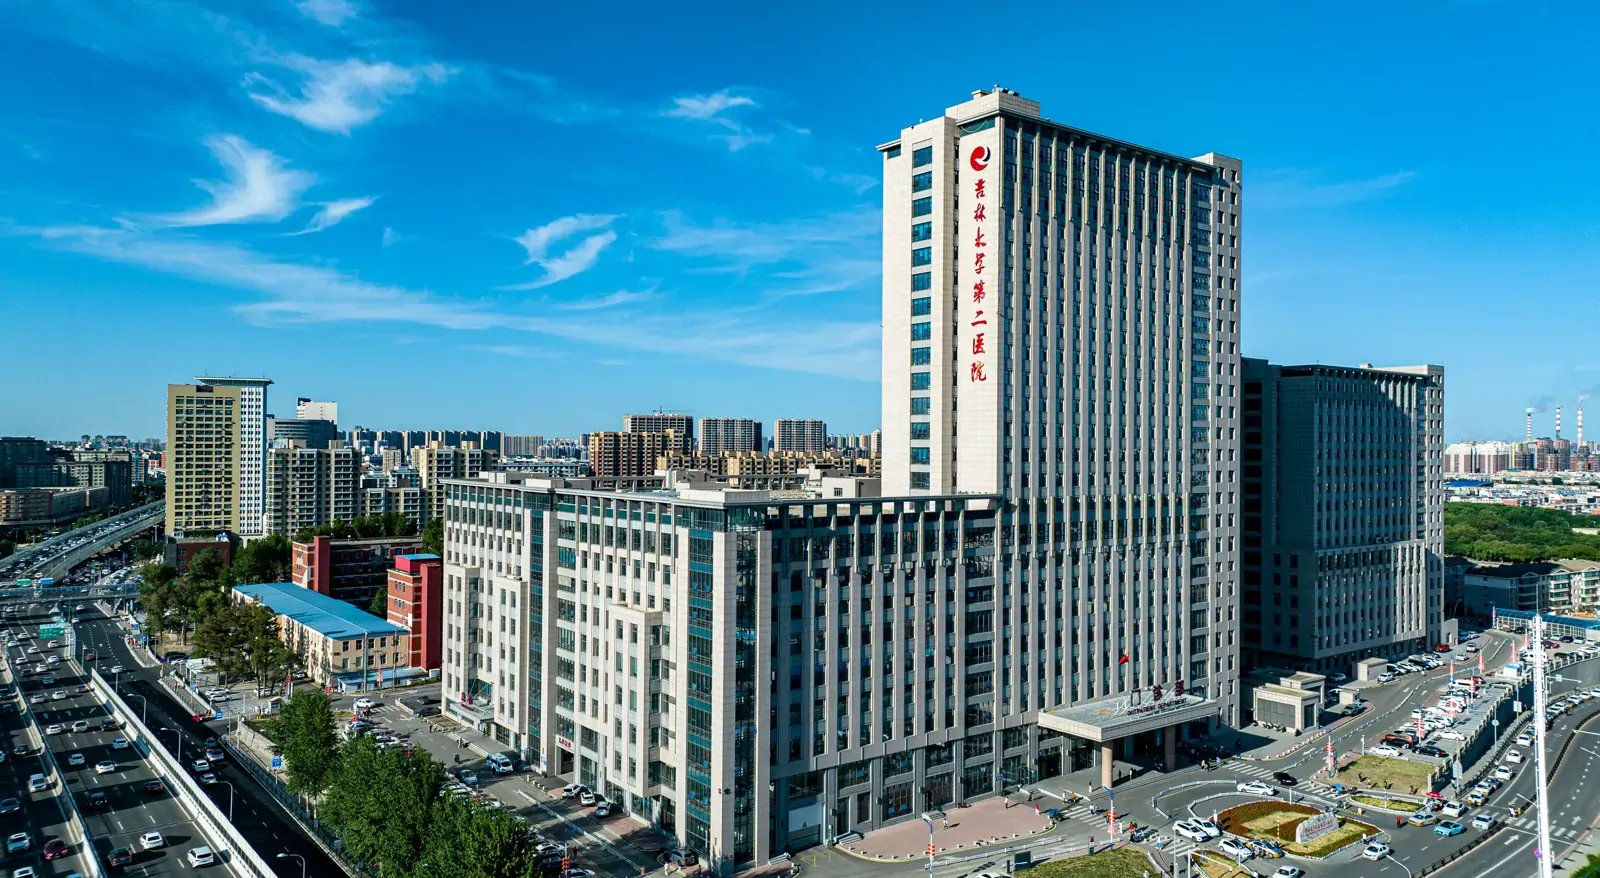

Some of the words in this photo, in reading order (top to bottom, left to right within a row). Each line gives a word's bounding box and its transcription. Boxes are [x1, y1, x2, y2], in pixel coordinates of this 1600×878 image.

[970, 178, 988, 383] 吉林大学第二医院
